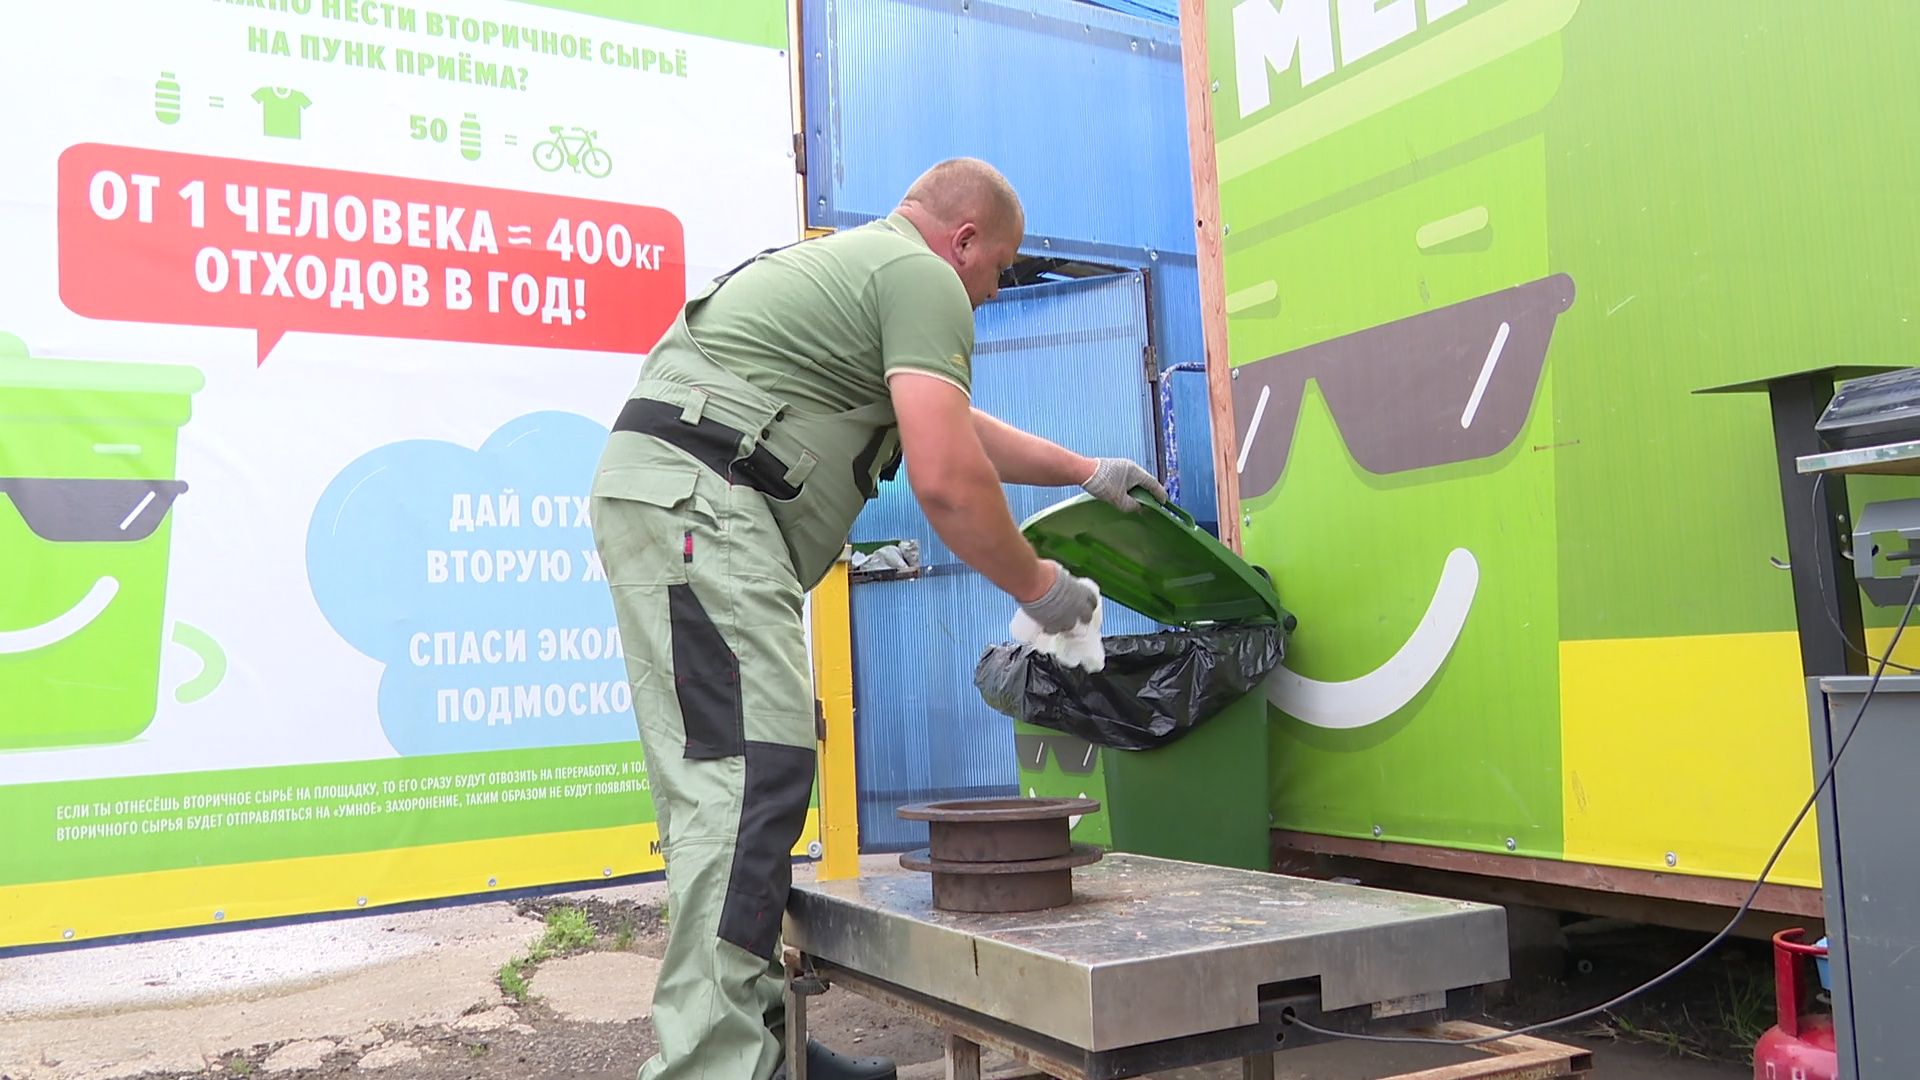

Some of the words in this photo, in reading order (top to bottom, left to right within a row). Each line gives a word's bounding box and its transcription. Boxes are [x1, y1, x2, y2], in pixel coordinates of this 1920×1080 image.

[248, 26, 291, 57] НА
[300, 34, 386, 71] ПУНК
[395, 48, 529, 91] ПРИЁМА?
[322, 0, 416, 33] НЕСТИ
[426, 11, 593, 62] ВТОРИЧНОЕ
[600, 41, 688, 78] СЫРЬЁ
[410, 114, 448, 143] 50
[89, 170, 160, 224] ОТ
[178, 180, 205, 228] 1
[225, 183, 499, 255] ЧЕЛОВЕКА
[195, 246, 430, 310] ОТХОДОВ
[445, 267, 473, 311] В
[488, 271, 588, 325] ГОД!
[449, 488, 520, 532] ДАЙ
[427, 549, 572, 583] ВТОРУЮ
[409, 629, 527, 667] СПАСИ
[57, 804, 89, 820] ЕСЛИ
[94, 803, 111, 817] ТЫ
[115, 796, 180, 815] ОТНЕСЁШЬ
[183, 791, 251, 810] ВТОРИЧНОЕ
[255, 785, 293, 804] СЫРЬЁ
[297, 787, 311, 800] НА
[314, 782, 379, 799] ПЛОЩАДКУ,
[382, 780, 396, 794] ТО
[399, 778, 418, 793] ЕГО
[420, 775, 452, 791] СРАЗУ
[455, 773, 486, 788] БУДУТ
[489, 769, 538, 785] ОТВОЗИТЬ
[540, 768, 553, 781] НА
[555, 763, 620, 780] ПЕРЕРАБОТКУ,
[622, 761, 629, 774] И
[57, 821, 138, 842] ВТОРИЧНОГО
[142, 818, 183, 834] СЫРЬЯ
[187, 814, 223, 831] БУДЕТ
[227, 807, 312, 826] ОТПРАВЛЯТЬСЯ
[316, 806, 330, 819] НА
[333, 802, 382, 818] «УМНОЕ»
[386, 794, 463, 814] ЗАХОРОНЕНИЕ,
[465, 791, 499, 806] ТАКИМ
[502, 787, 547, 803] ОБРАЗОМ
[550, 785, 562, 798] НЕ
[564, 782, 592, 798] БУДУТ
